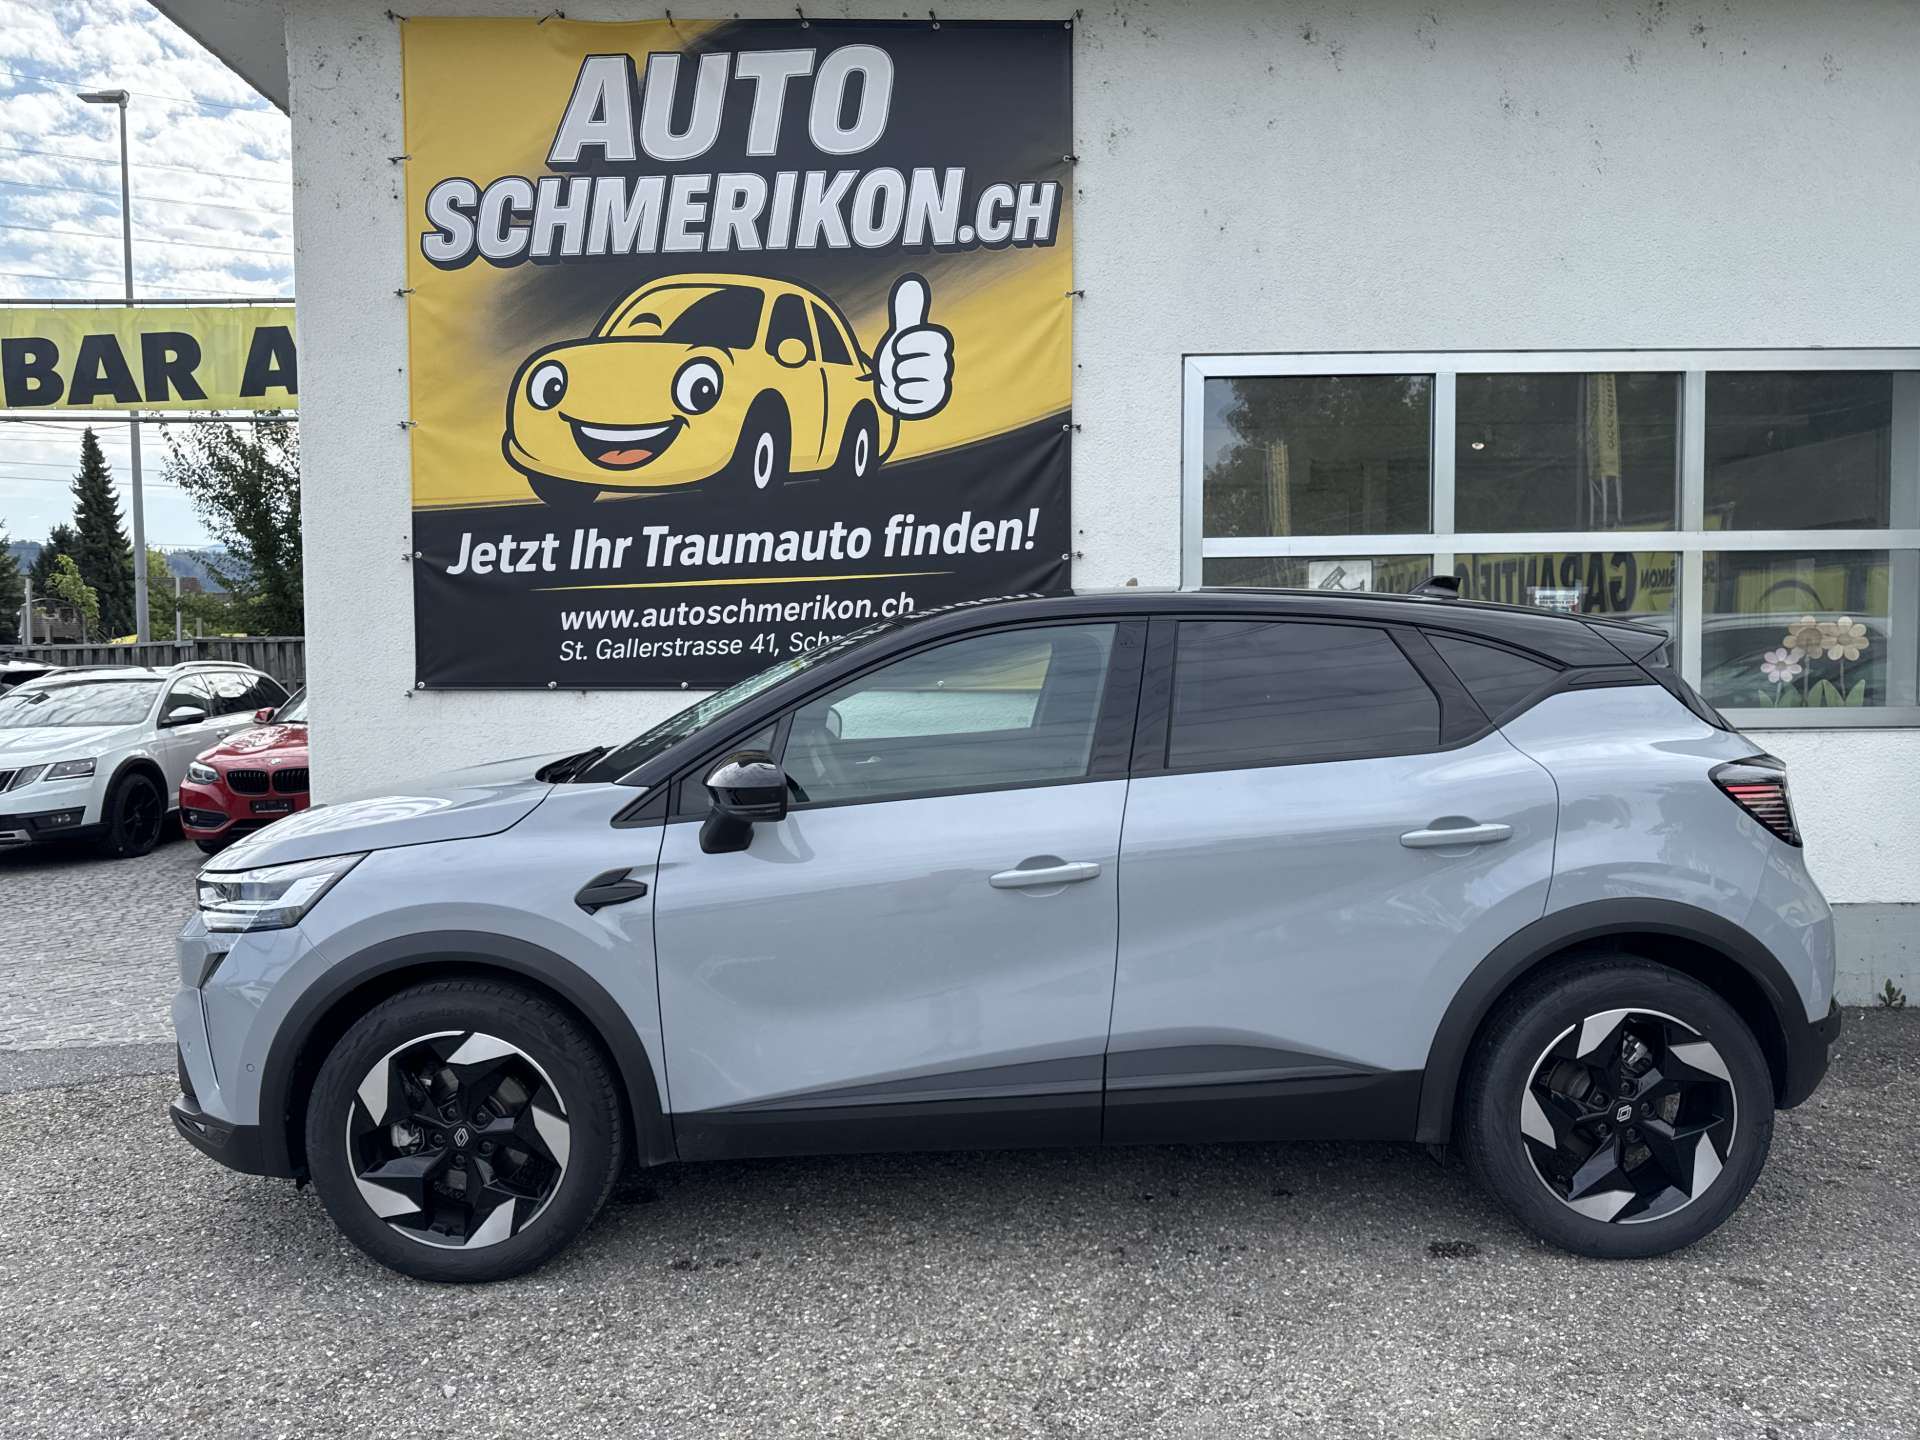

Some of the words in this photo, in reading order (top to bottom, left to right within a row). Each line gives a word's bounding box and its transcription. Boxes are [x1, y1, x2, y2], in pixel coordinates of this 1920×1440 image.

[546, 44, 895, 165] AUTO
[422, 166, 1060, 264] SCHMERIKON.CH
[1, 331, 208, 408] BAR
[446, 532, 560, 575] Jetzt
[570, 528, 632, 570] Ihr
[642, 521, 872, 567] Traumauto
[884, 507, 1040, 557] finden!
[560, 640, 588, 661] St.
[596, 638, 743, 660] Gallerstrasse
[749, 633, 779, 656] 41,
[561, 592, 914, 631] www.autoschmerikon.ch
